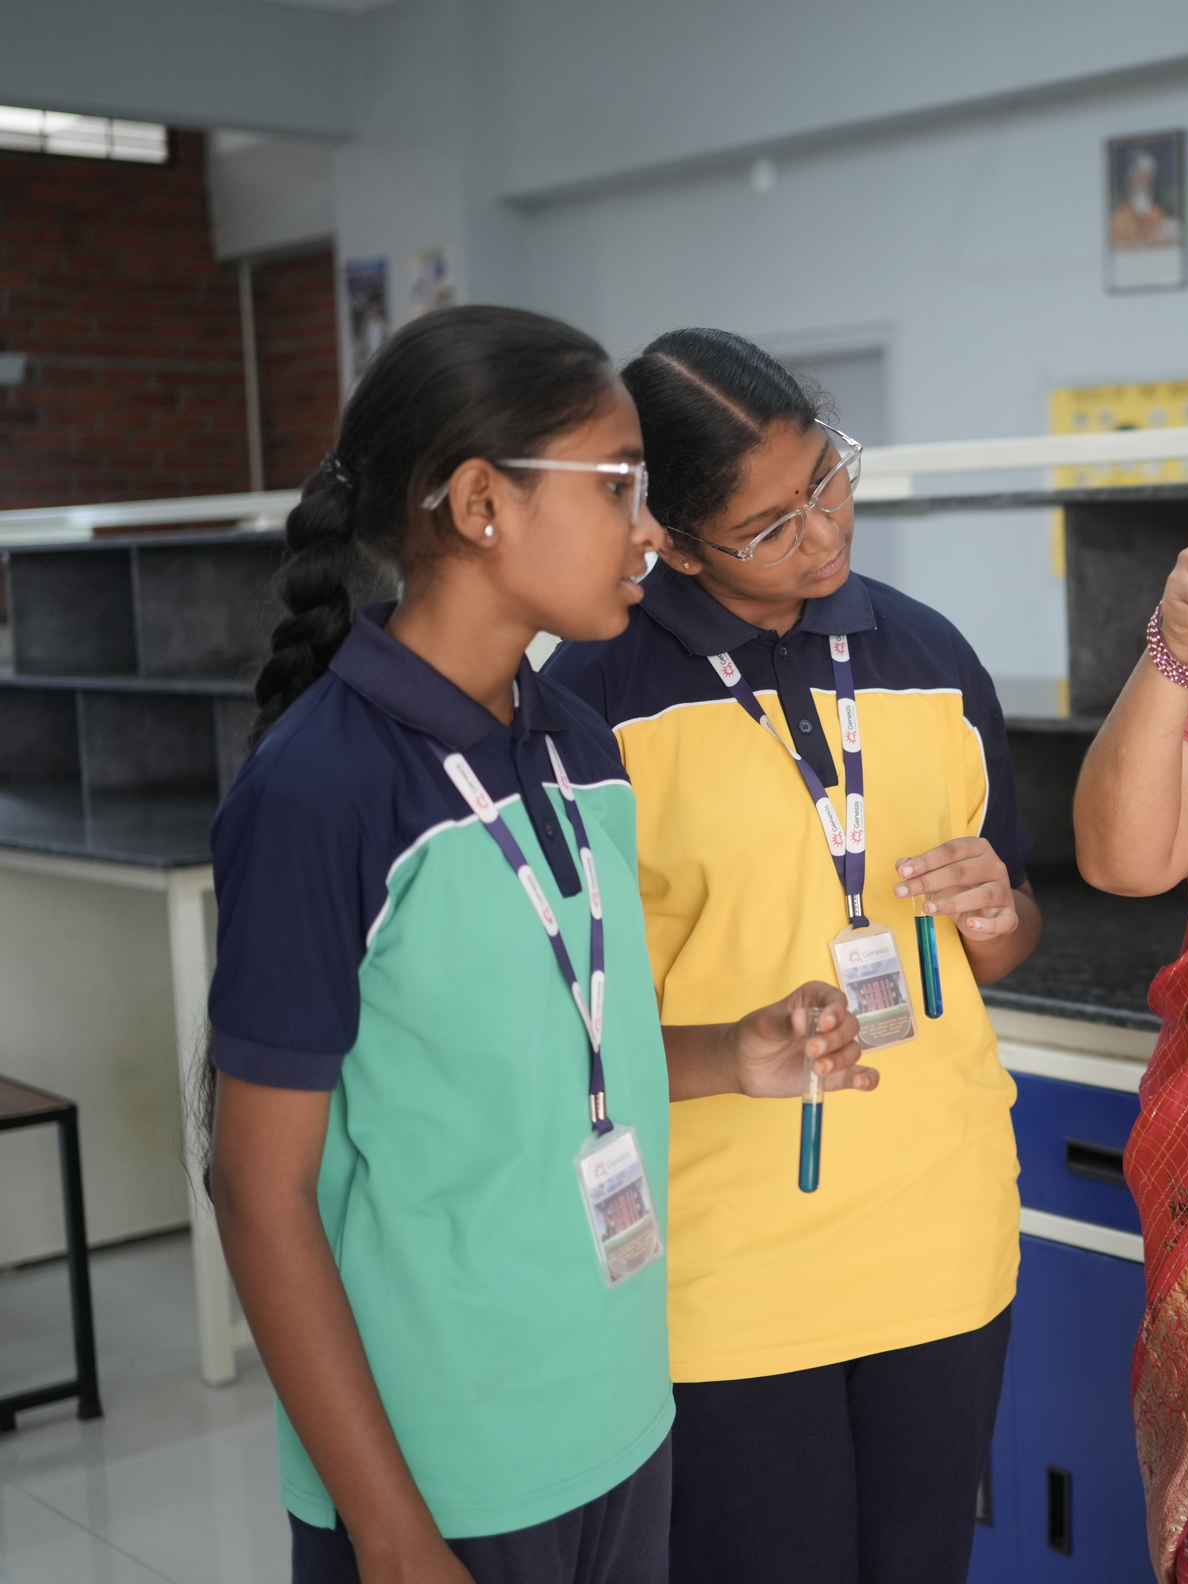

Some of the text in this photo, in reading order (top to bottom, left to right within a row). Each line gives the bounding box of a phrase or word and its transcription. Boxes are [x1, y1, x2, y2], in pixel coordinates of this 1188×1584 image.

[846, 704, 854, 731] Genesis
[823, 803, 838, 833] Genesis
[862, 946, 890, 959] Genesis
